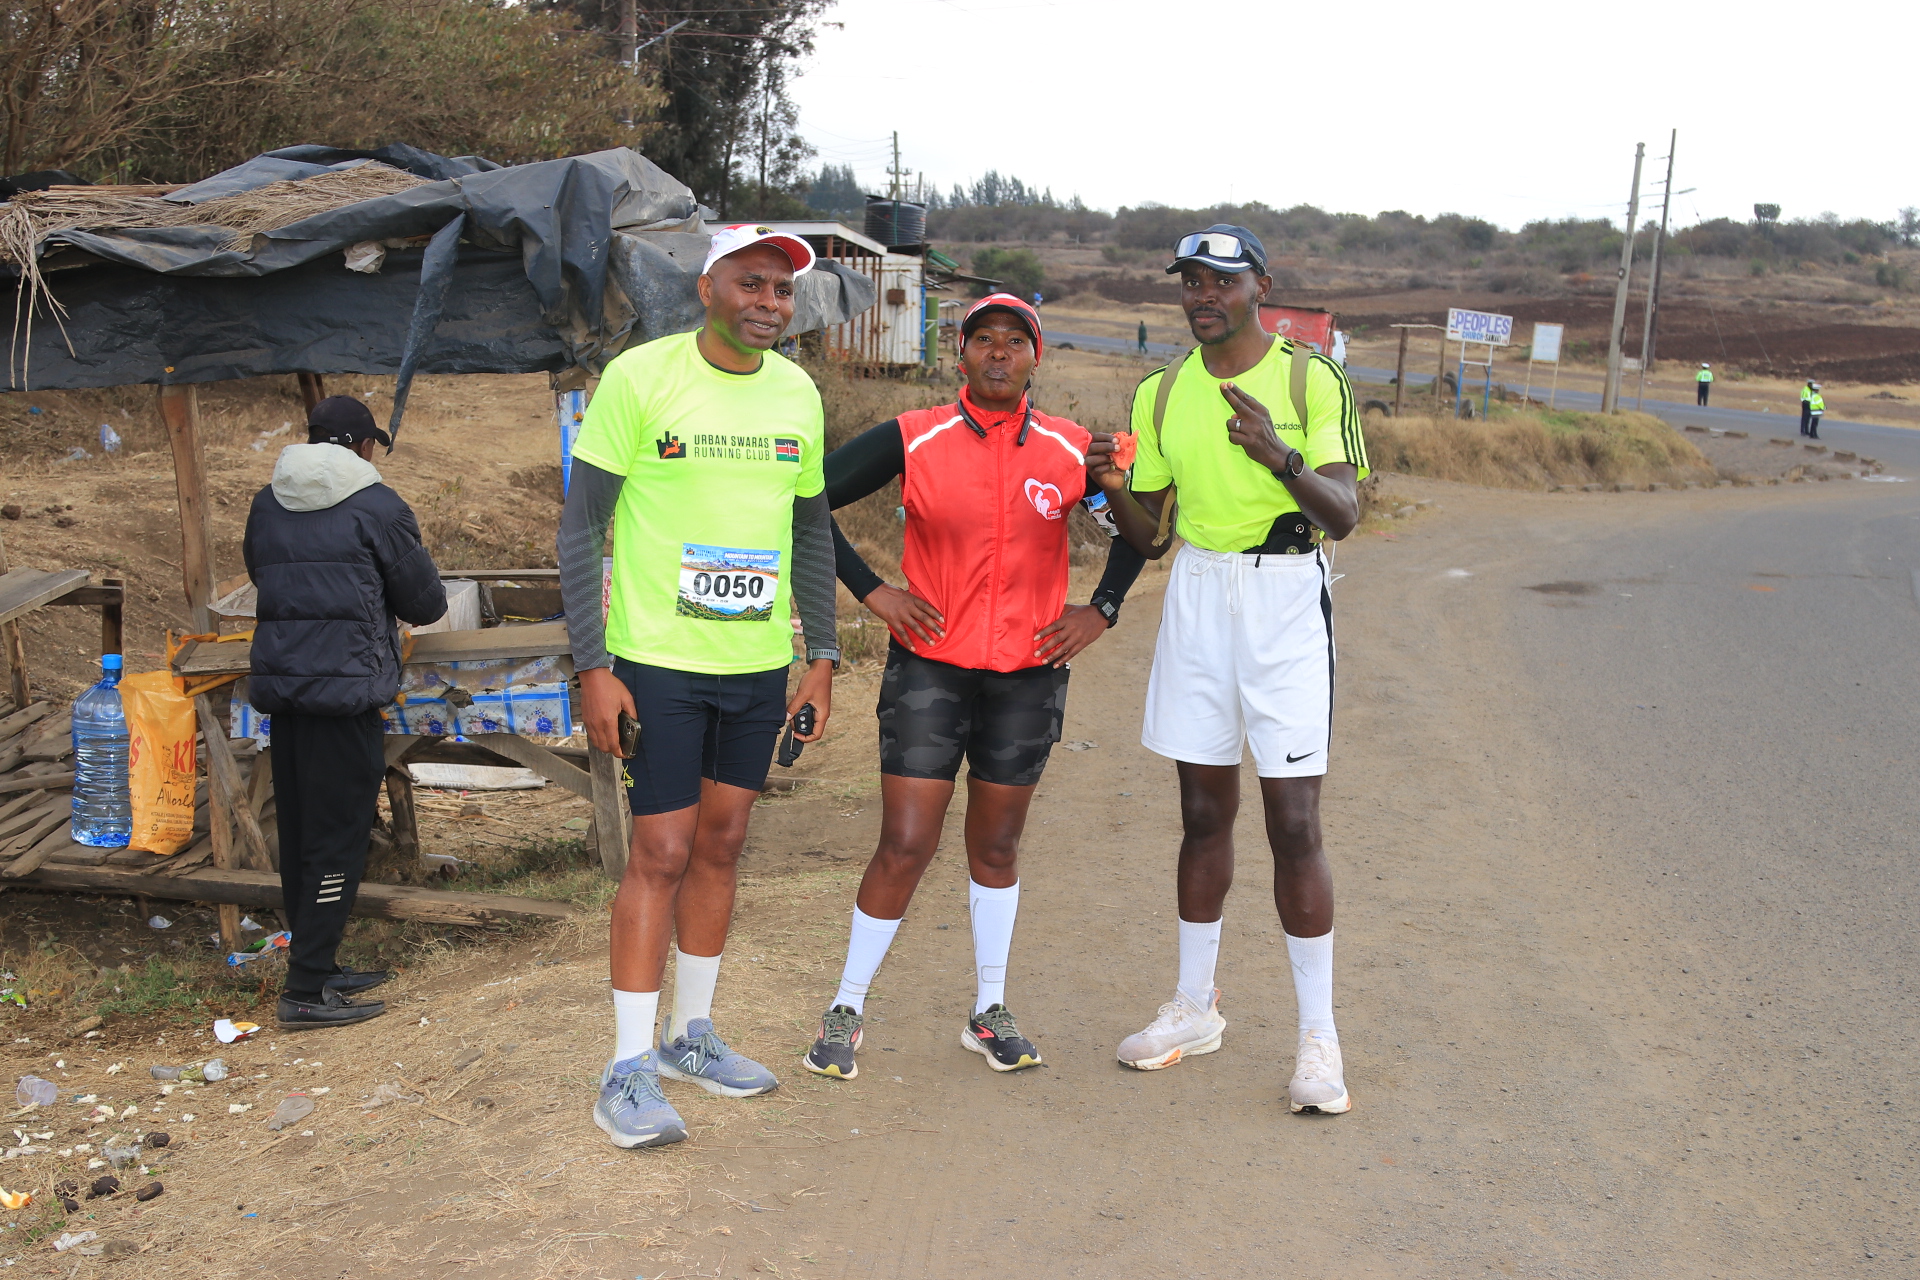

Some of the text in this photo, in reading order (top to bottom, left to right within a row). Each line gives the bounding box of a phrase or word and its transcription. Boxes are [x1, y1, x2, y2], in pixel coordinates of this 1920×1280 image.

[1455, 311, 1511, 335] PEOPLES
[1274, 422, 1302, 431] adidas
[694, 434, 769, 448] URBAN SWARAS
[694, 447, 770, 460] RUNNING CLUB
[693, 572, 764, 598] 0050
